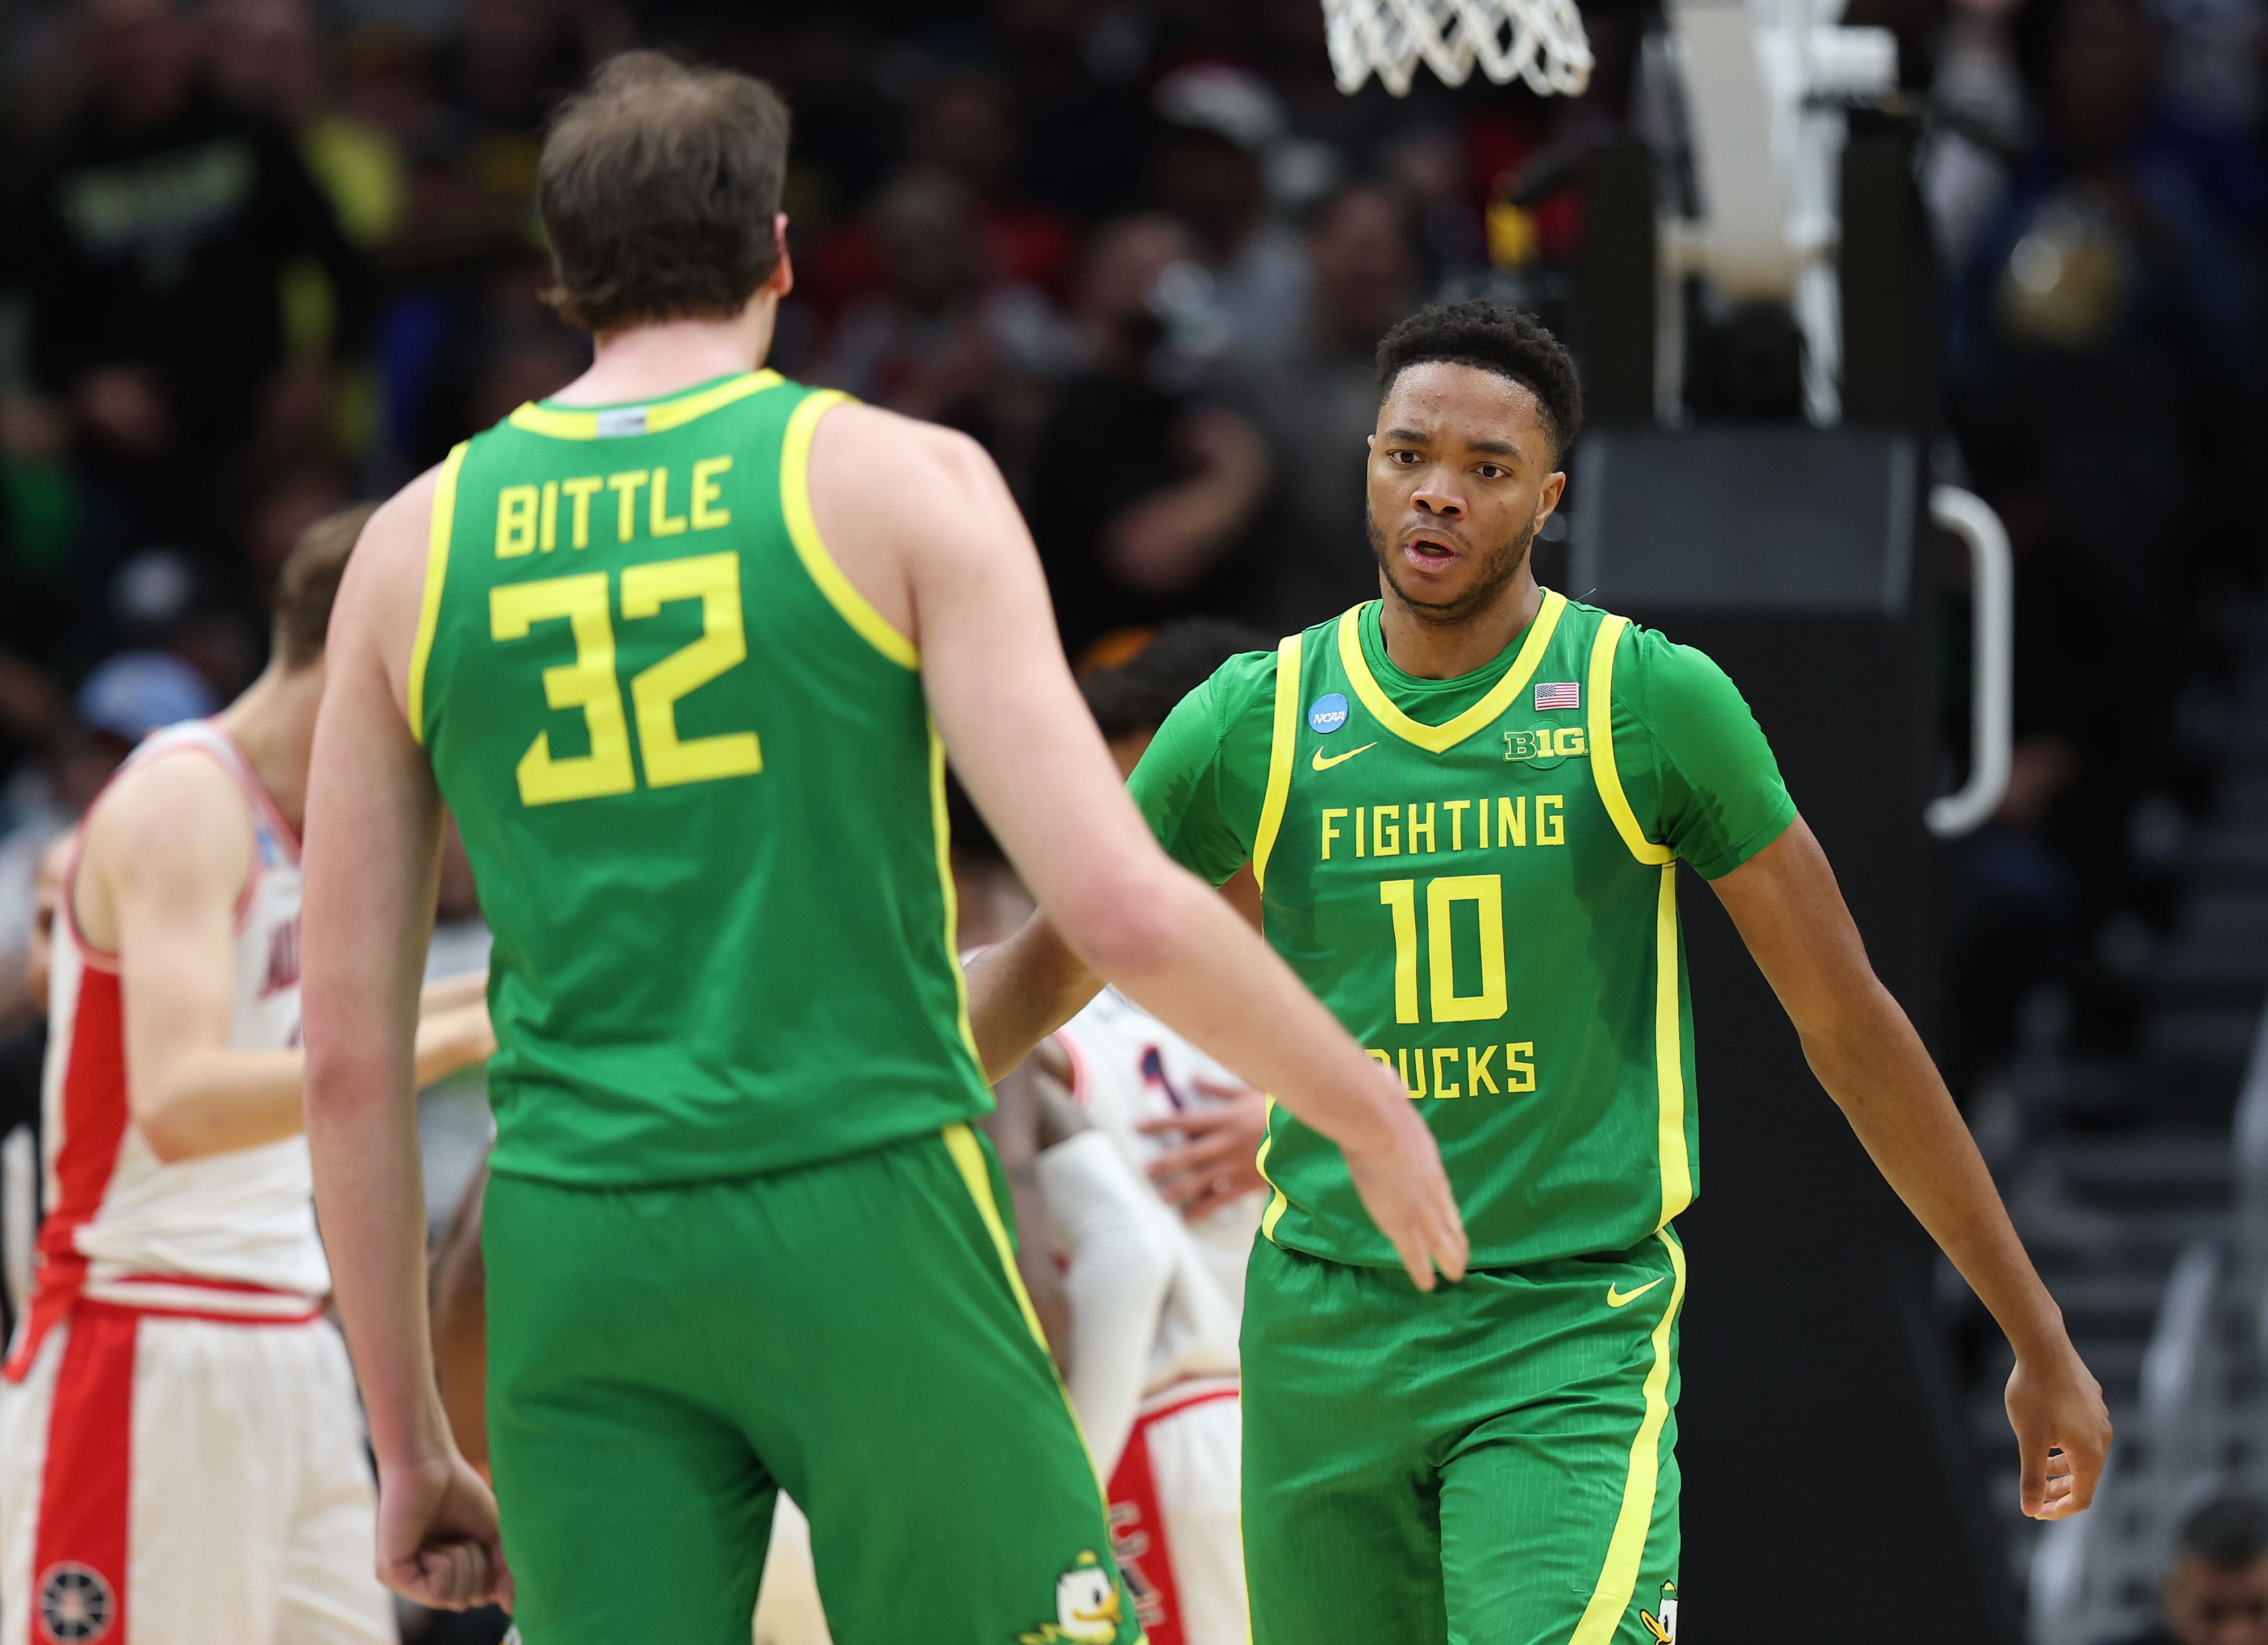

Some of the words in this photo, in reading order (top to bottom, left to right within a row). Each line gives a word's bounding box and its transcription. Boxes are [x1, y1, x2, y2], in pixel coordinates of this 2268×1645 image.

[495, 454, 733, 559] BITTLE
[489, 550, 764, 807] 32
[1313, 711, 1346, 725] NCAA
[1321, 795, 1565, 860] FIGHTING
[1379, 874, 1508, 1024] 10
